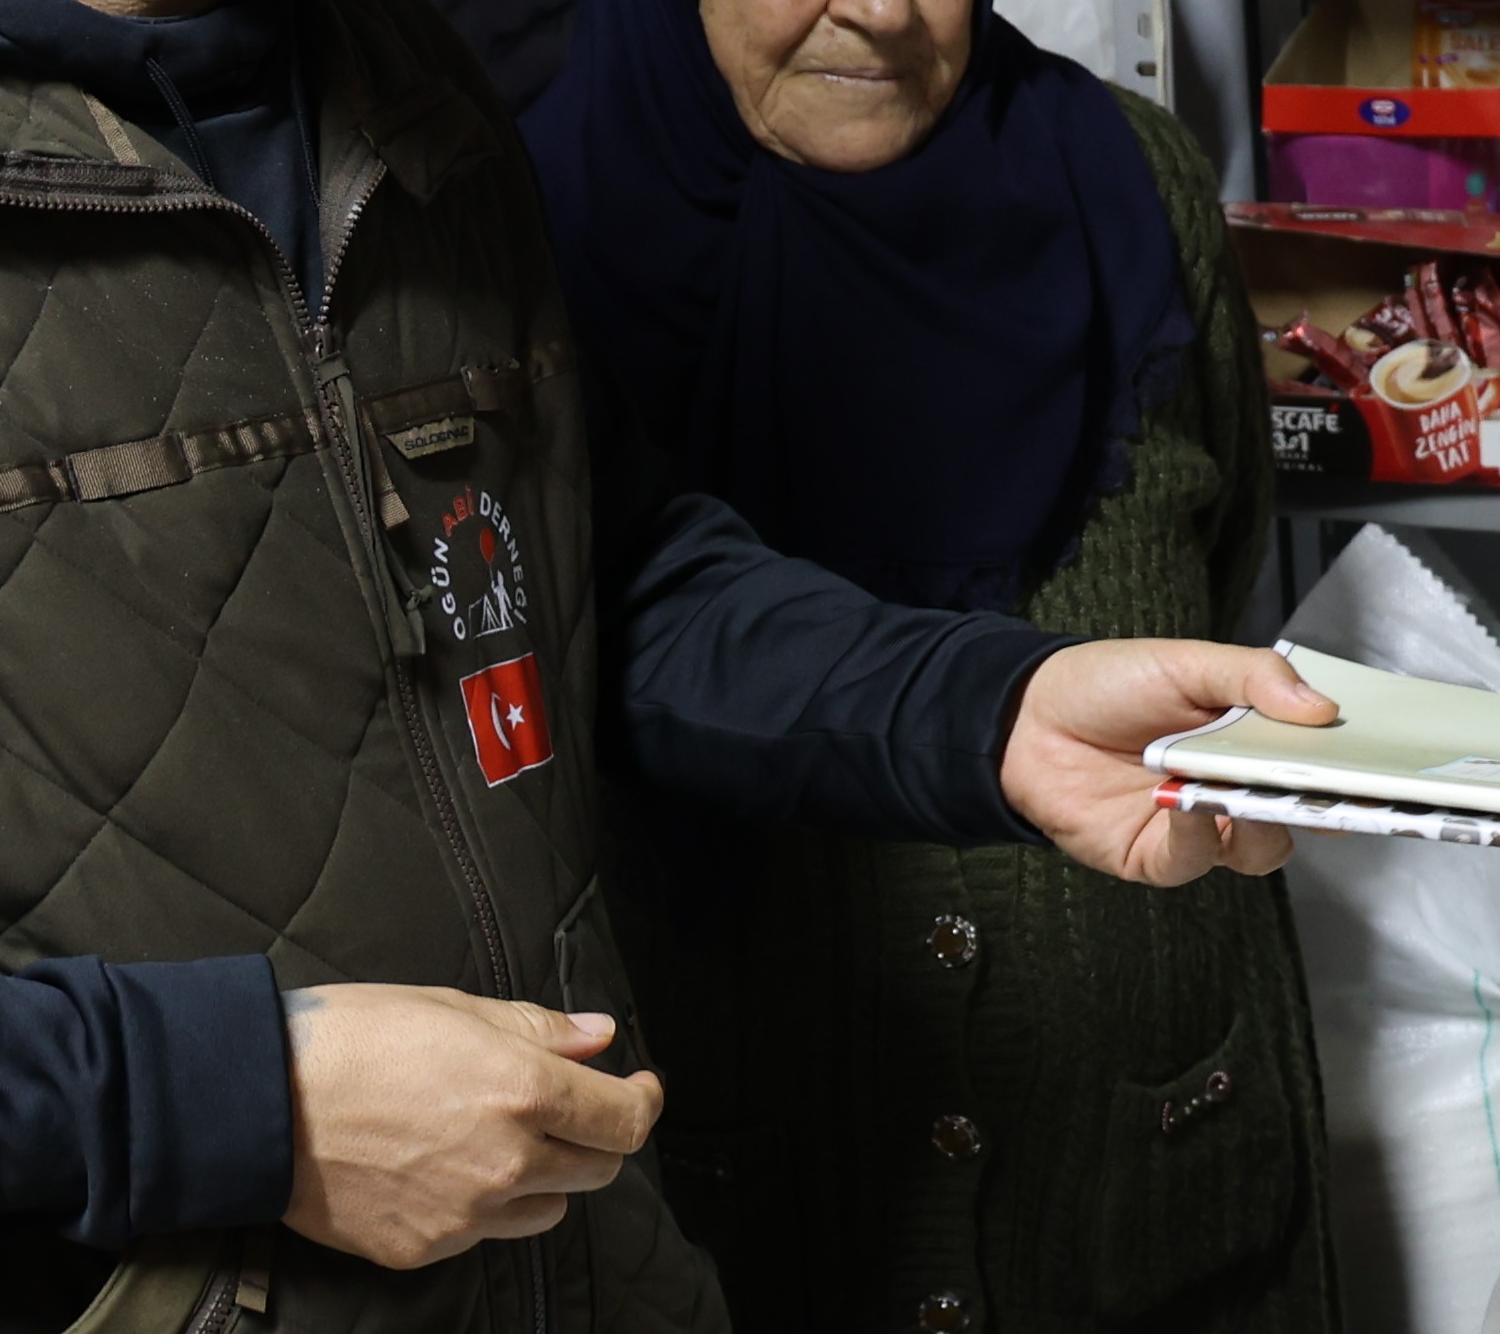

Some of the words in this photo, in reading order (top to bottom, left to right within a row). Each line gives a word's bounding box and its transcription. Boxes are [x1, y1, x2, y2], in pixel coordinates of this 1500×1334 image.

[1271, 402, 1339, 433] SCAFÉ
[1419, 401, 1462, 435] DAHA
[1414, 418, 1476, 460] ZENGİN
[1436, 442, 1471, 472] TAT
[442, 485, 476, 537] ABİ
